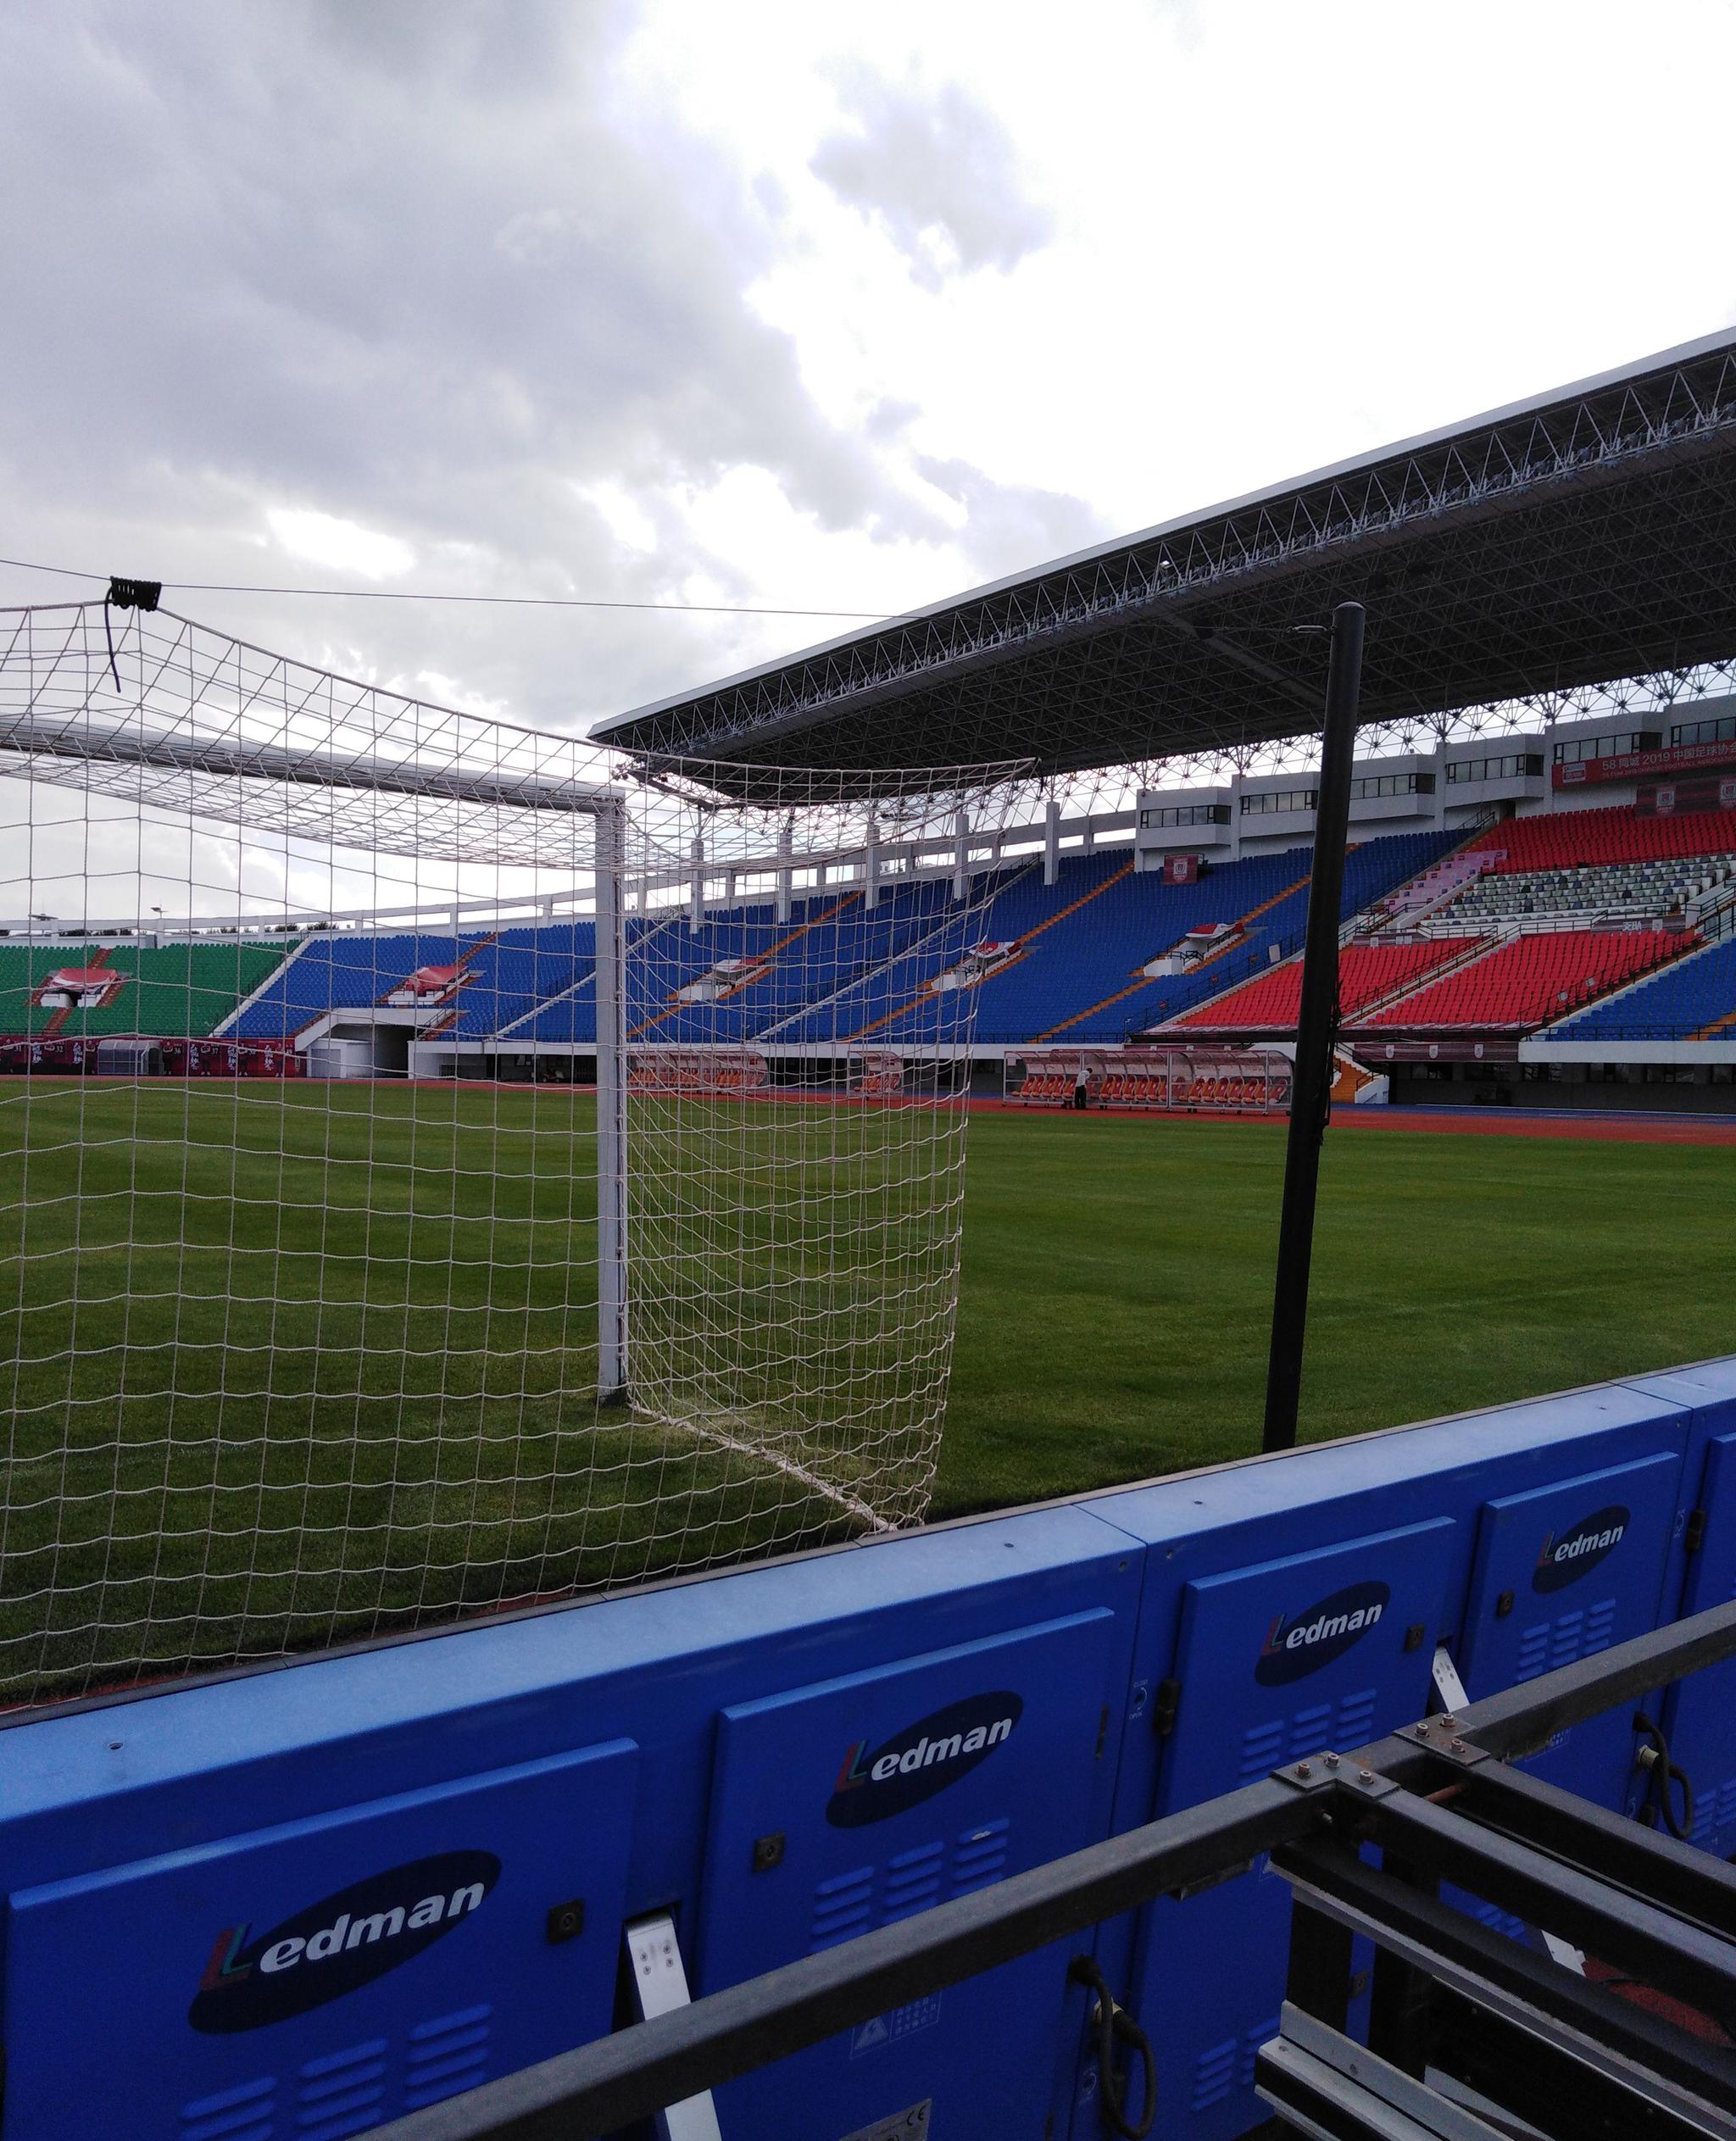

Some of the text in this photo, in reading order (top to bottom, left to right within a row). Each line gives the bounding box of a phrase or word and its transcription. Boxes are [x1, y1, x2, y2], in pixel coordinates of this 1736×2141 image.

[1602, 760, 1616, 771] 58
[1643, 752, 1671, 765] 2019
[1538, 1526, 1624, 1566] Ledman
[1261, 1604, 1383, 1655] Ledman
[835, 1718, 1013, 1793] Ledman
[200, 1882, 486, 1991] Ledman
